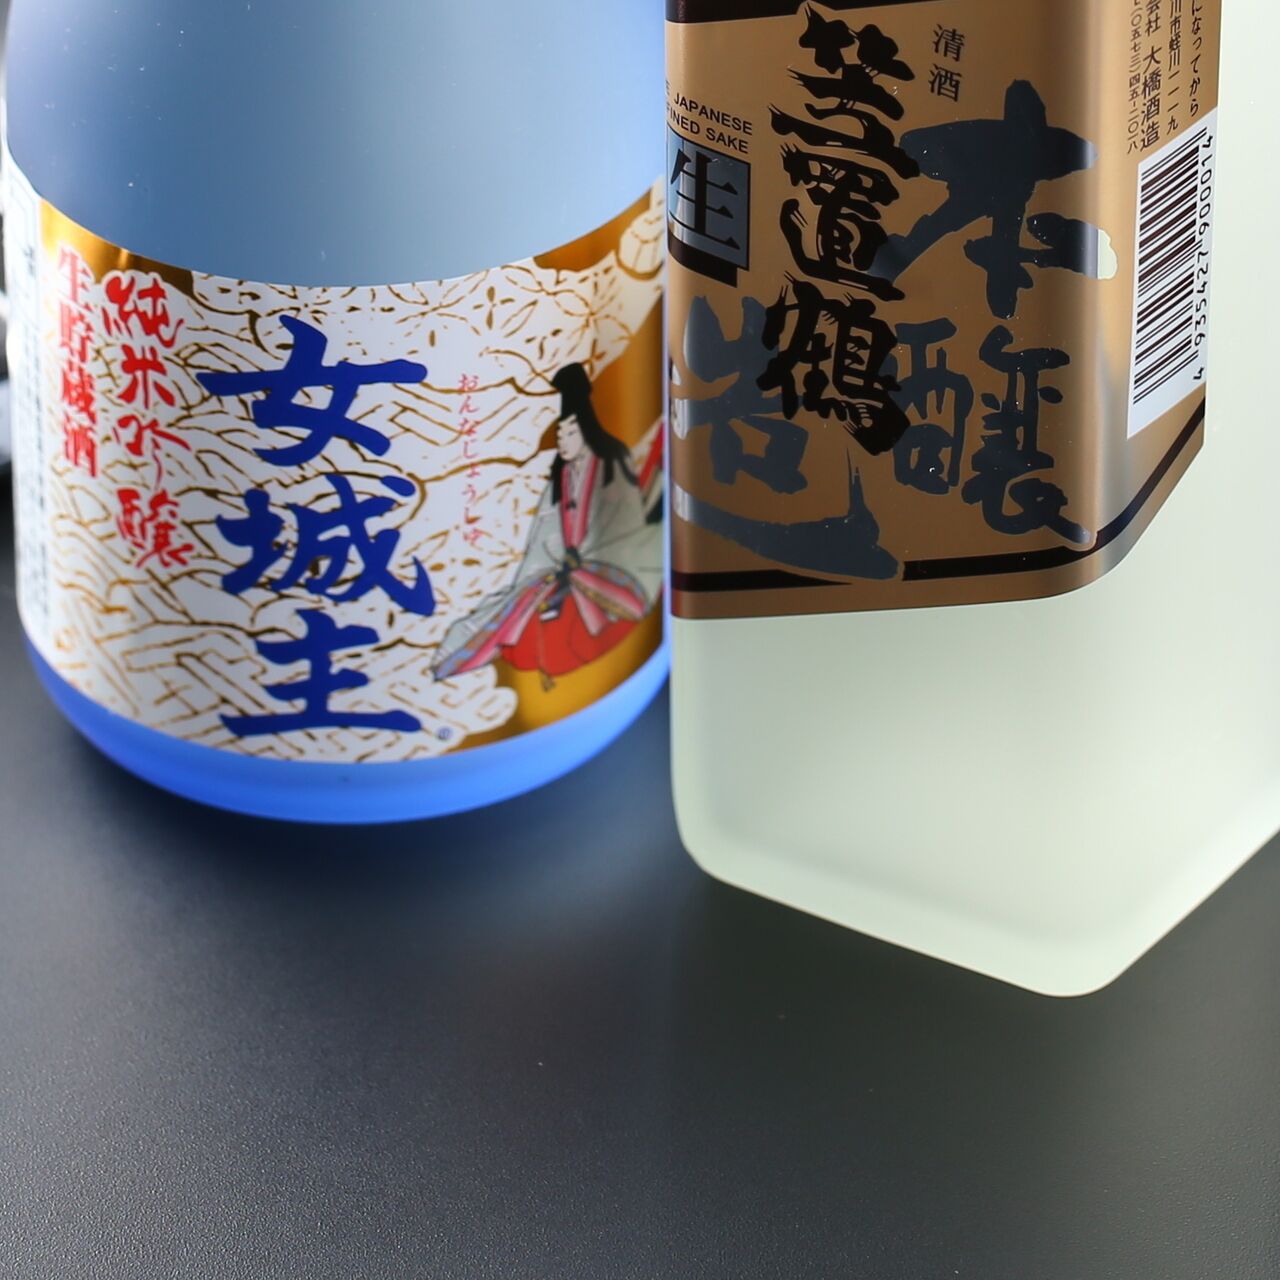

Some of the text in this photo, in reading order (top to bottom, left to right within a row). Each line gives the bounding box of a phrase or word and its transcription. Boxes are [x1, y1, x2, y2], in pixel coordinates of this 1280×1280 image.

[928, 23, 966, 102] 清酒
[1139, 45, 1163, 153] 大橋酒造
[674, 93, 753, 136] JAPANESE
[706, 127, 749, 154] SAKE
[670, 148, 741, 250] 生
[756, 1, 920, 455] 笠置鶴
[197, 314, 437, 734] 女城主
